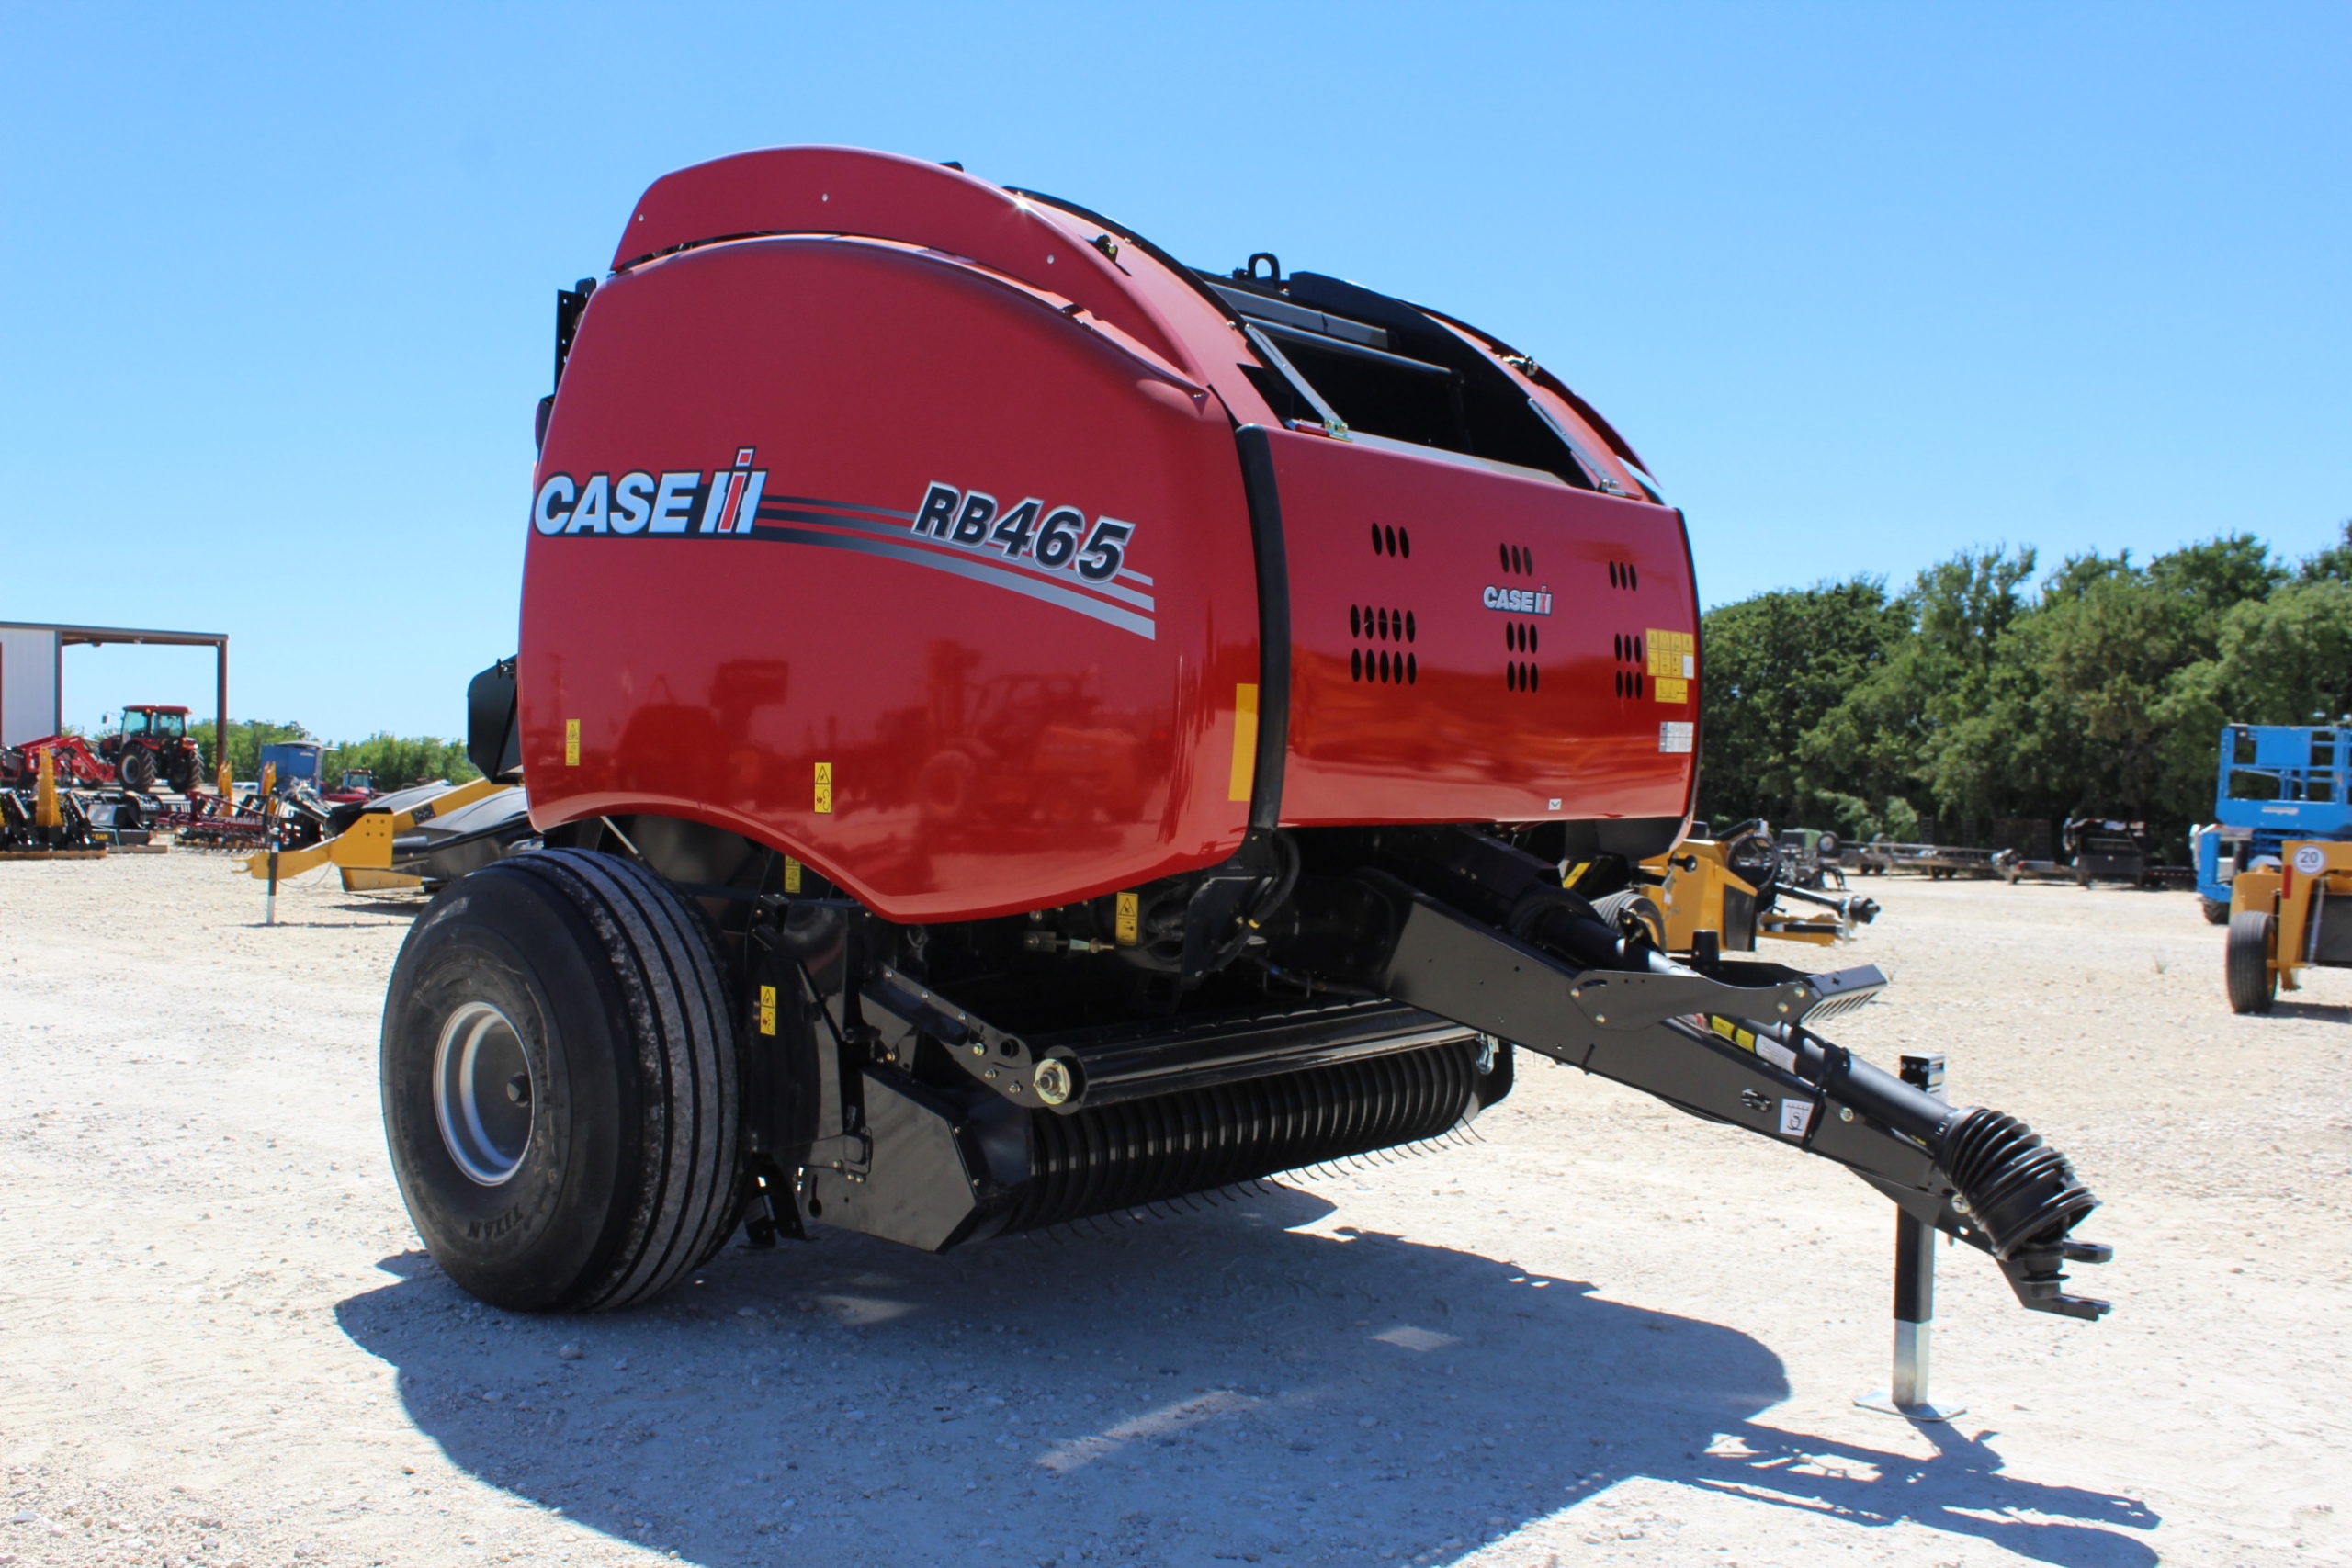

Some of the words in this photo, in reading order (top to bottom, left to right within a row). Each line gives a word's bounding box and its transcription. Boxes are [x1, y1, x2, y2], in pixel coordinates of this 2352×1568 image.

[535, 471, 702, 536] CASE
[911, 480, 1136, 583] RB465
[1483, 585, 1534, 613] CASE
[2300, 851, 2320, 863] 20
[467, 1201, 524, 1242] TITAN
